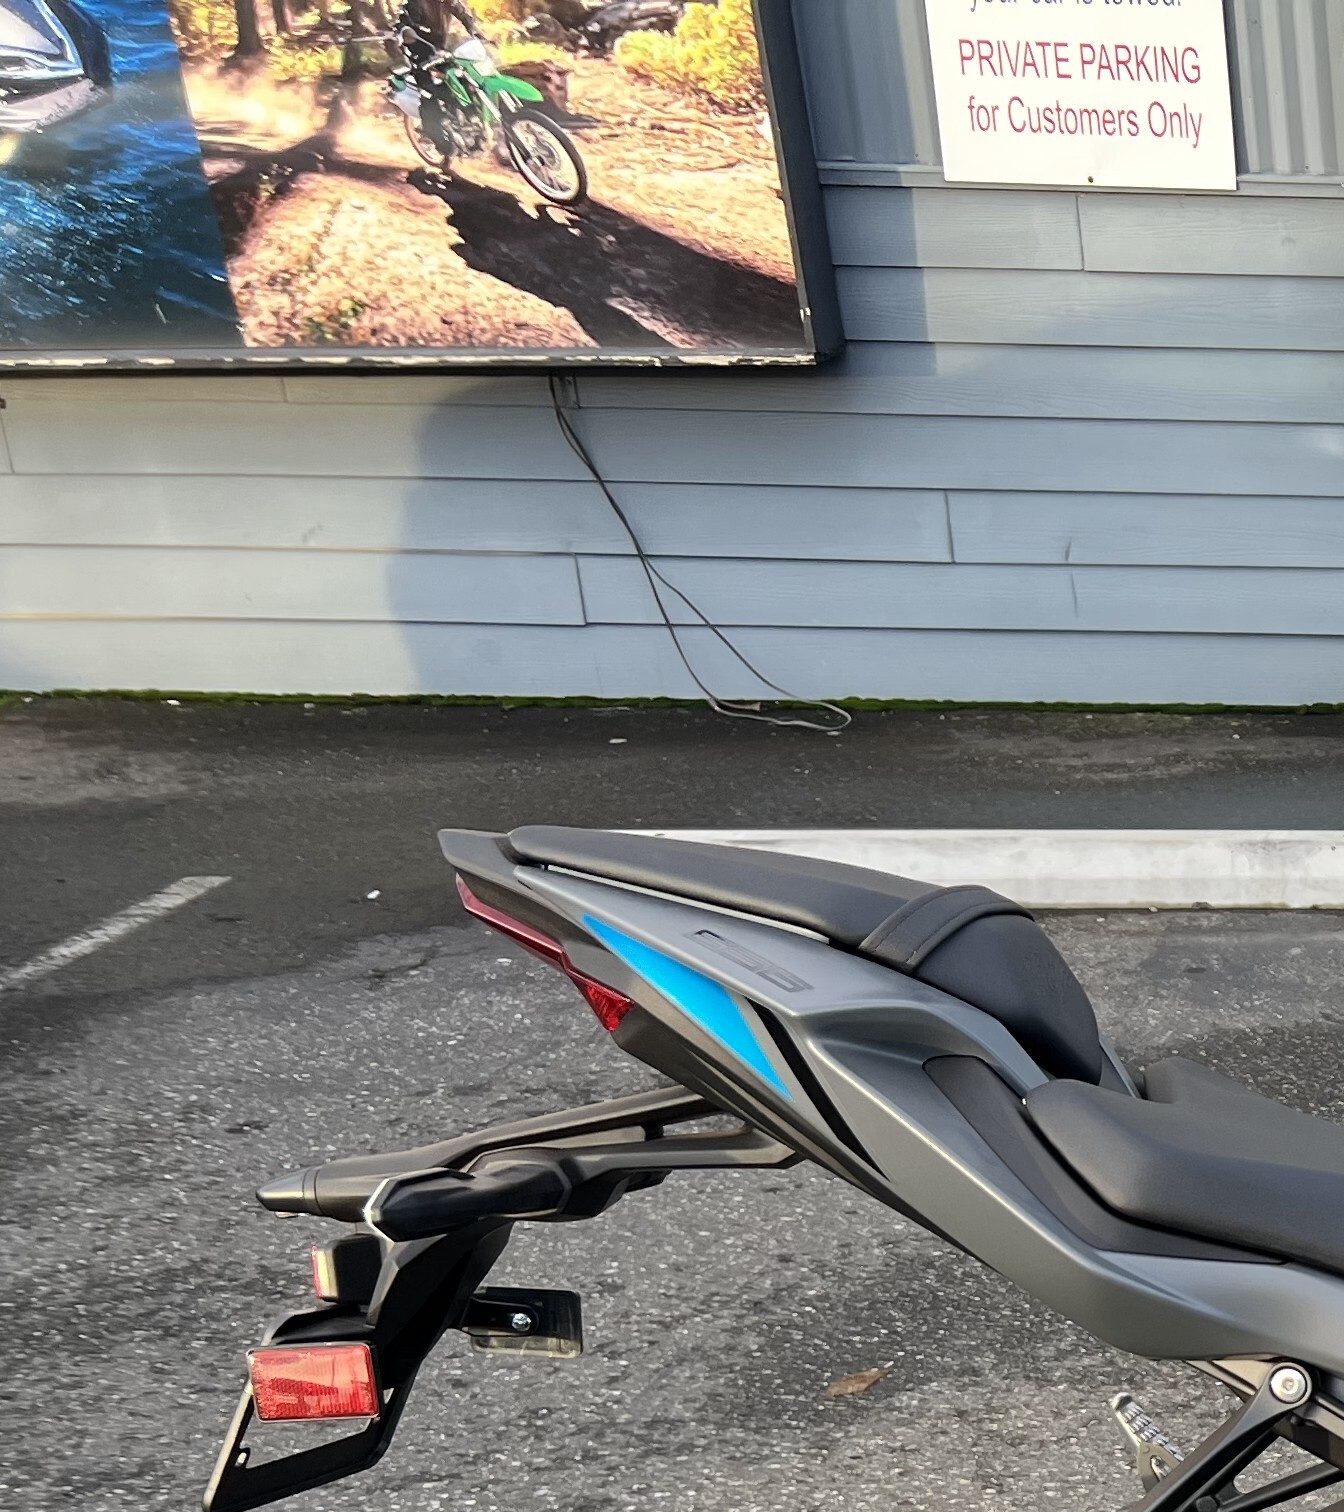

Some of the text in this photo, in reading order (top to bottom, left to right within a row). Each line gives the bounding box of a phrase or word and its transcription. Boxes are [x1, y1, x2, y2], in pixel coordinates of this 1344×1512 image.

[958, 39, 1201, 84] PRIVATE PARKING
[967, 95, 1202, 149] for Customers Only
